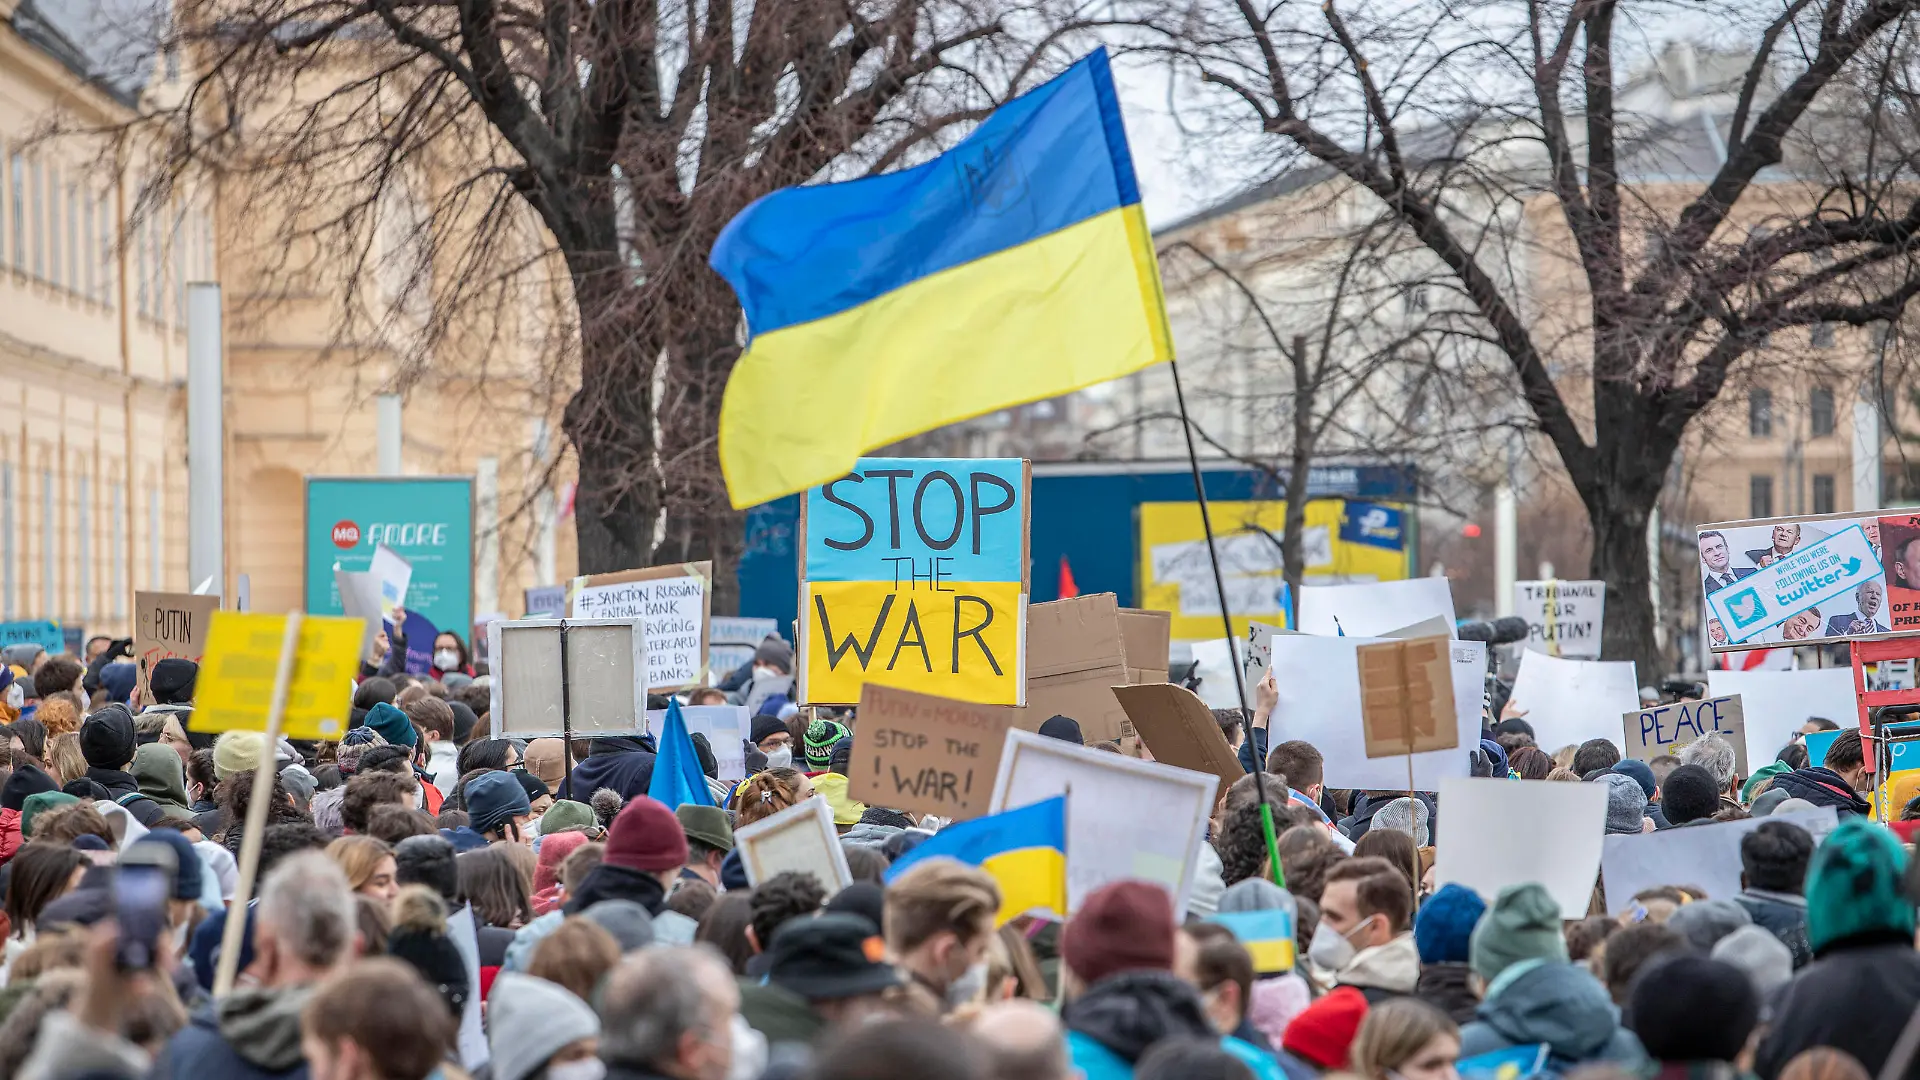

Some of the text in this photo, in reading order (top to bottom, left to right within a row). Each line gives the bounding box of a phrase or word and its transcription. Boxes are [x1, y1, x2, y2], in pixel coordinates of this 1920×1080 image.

[822, 469, 1015, 555] STOP
[881, 557, 955, 592] THE
[1775, 545, 1830, 575] WHILE YOU WERE
[1775, 553, 1841, 590] FOLLOWING US ON
[1775, 568, 1842, 606] twitter
[592, 600, 679, 619] CENTRAL BANK
[1893, 603, 1911, 612] OF
[155, 608, 192, 644] PUTIN
[644, 618, 695, 635] RVICING
[814, 594, 1004, 676] WAR
[1528, 621, 1593, 643] PUTIN!
[646, 637, 697, 651] TERCARD
[674, 653, 690, 666] BY
[650, 668, 694, 683] BANKS
[1640, 698, 1734, 746] PEACE
[875, 728, 980, 758] STOP THE
